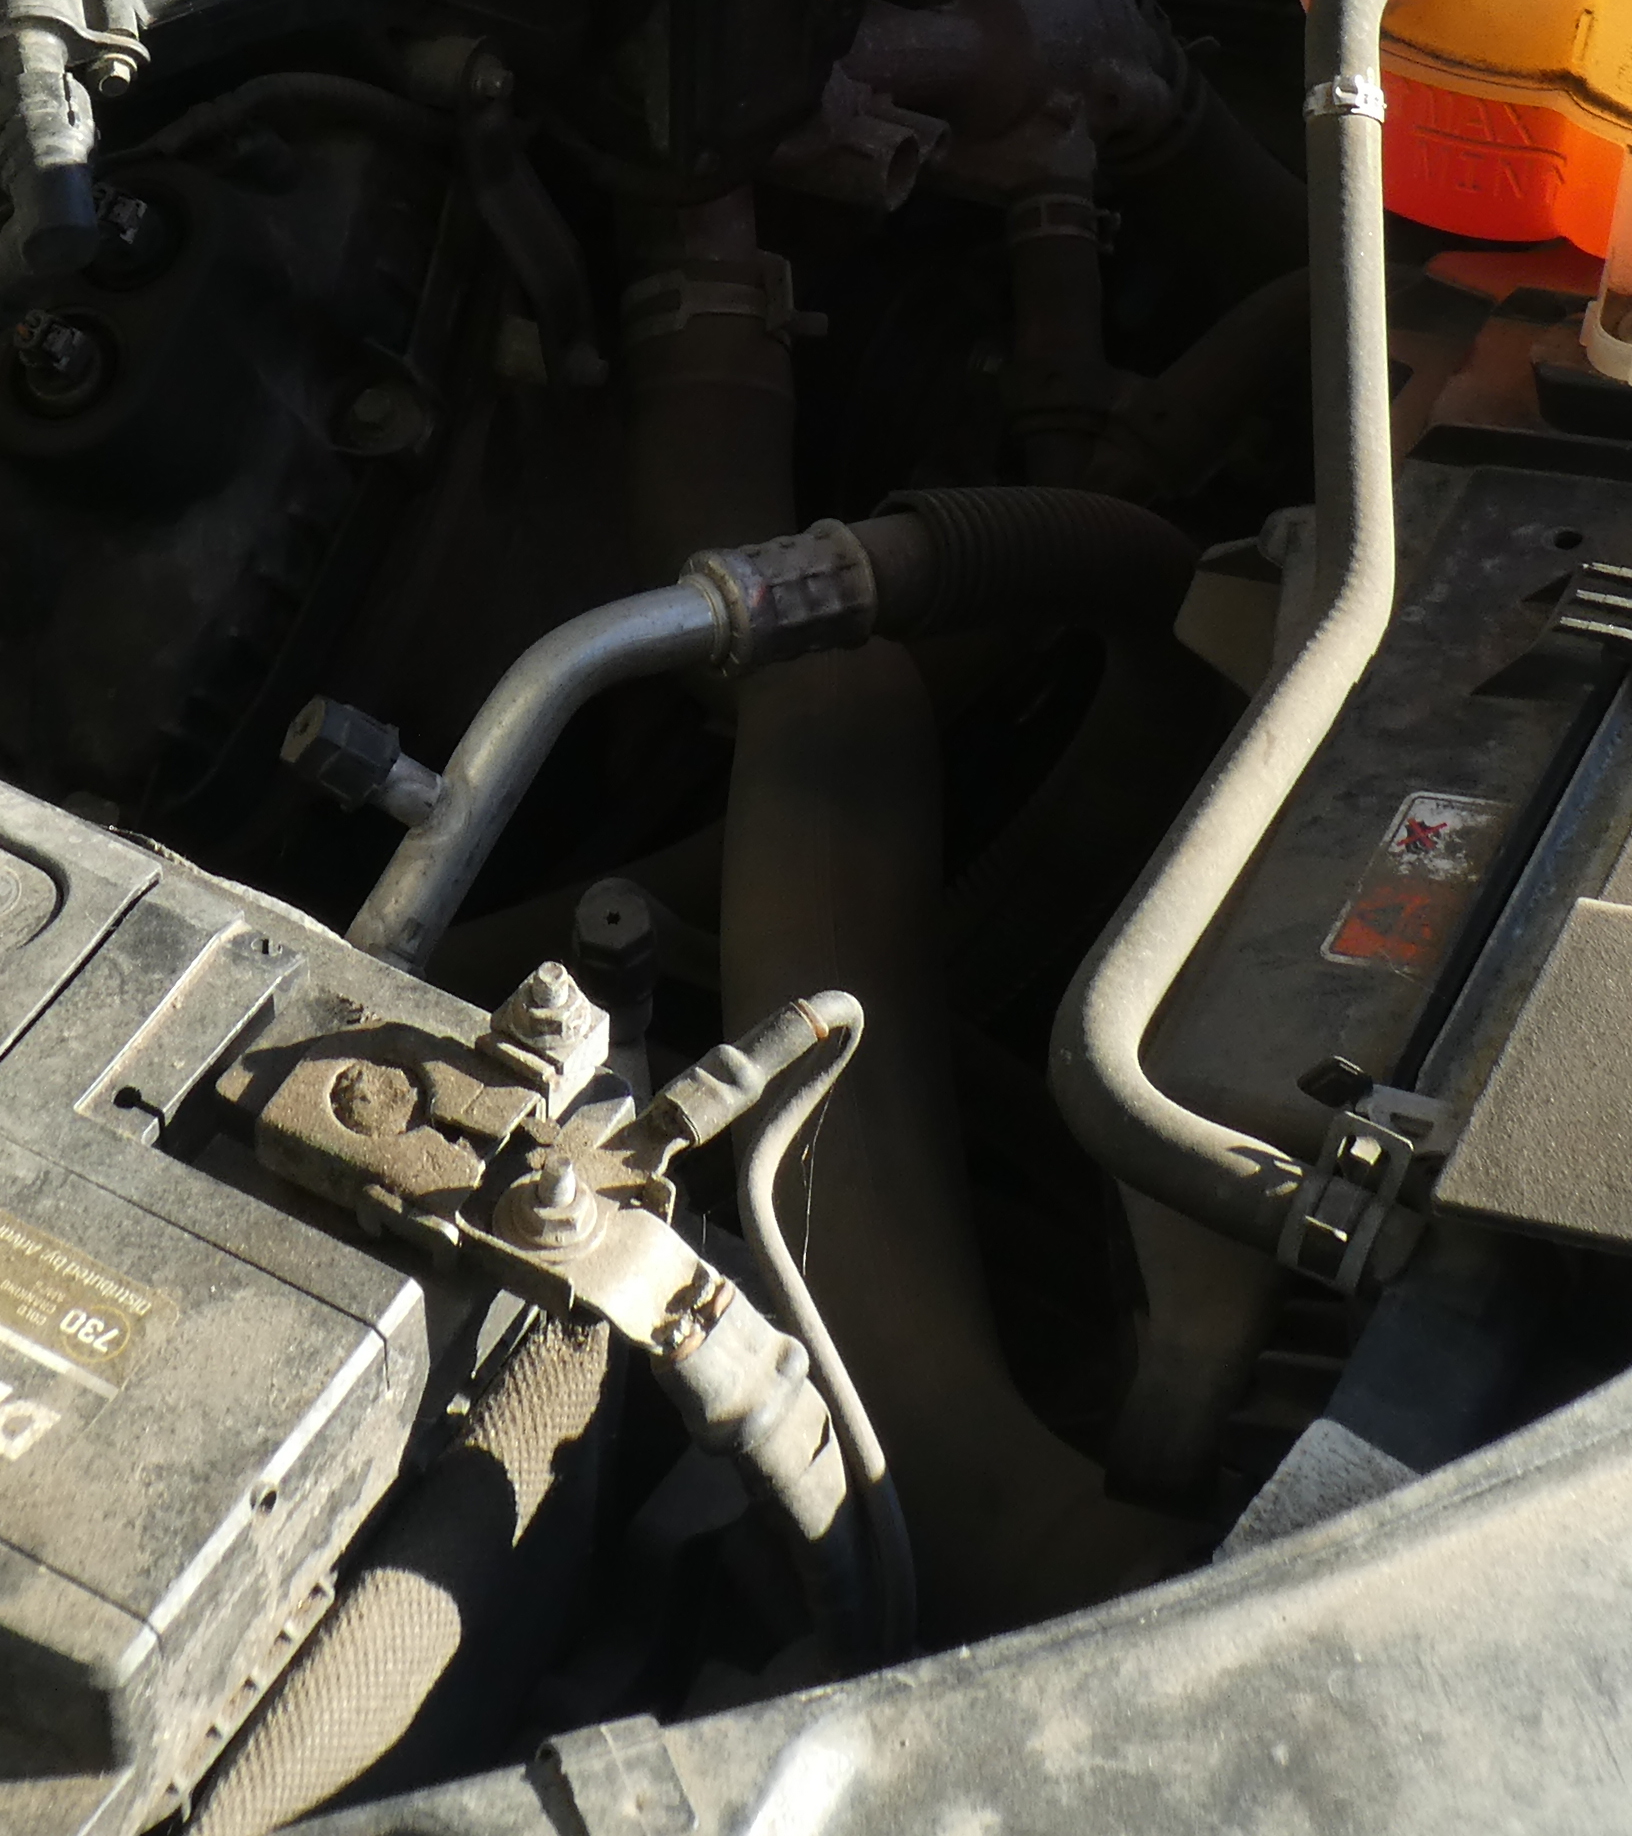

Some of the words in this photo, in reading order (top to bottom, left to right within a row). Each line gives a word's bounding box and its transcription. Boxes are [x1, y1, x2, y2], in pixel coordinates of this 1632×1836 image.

[36, 1244, 70, 1272] by:
[64, 1261, 152, 1317] Distributed
[56, 1305, 120, 1353] 730
